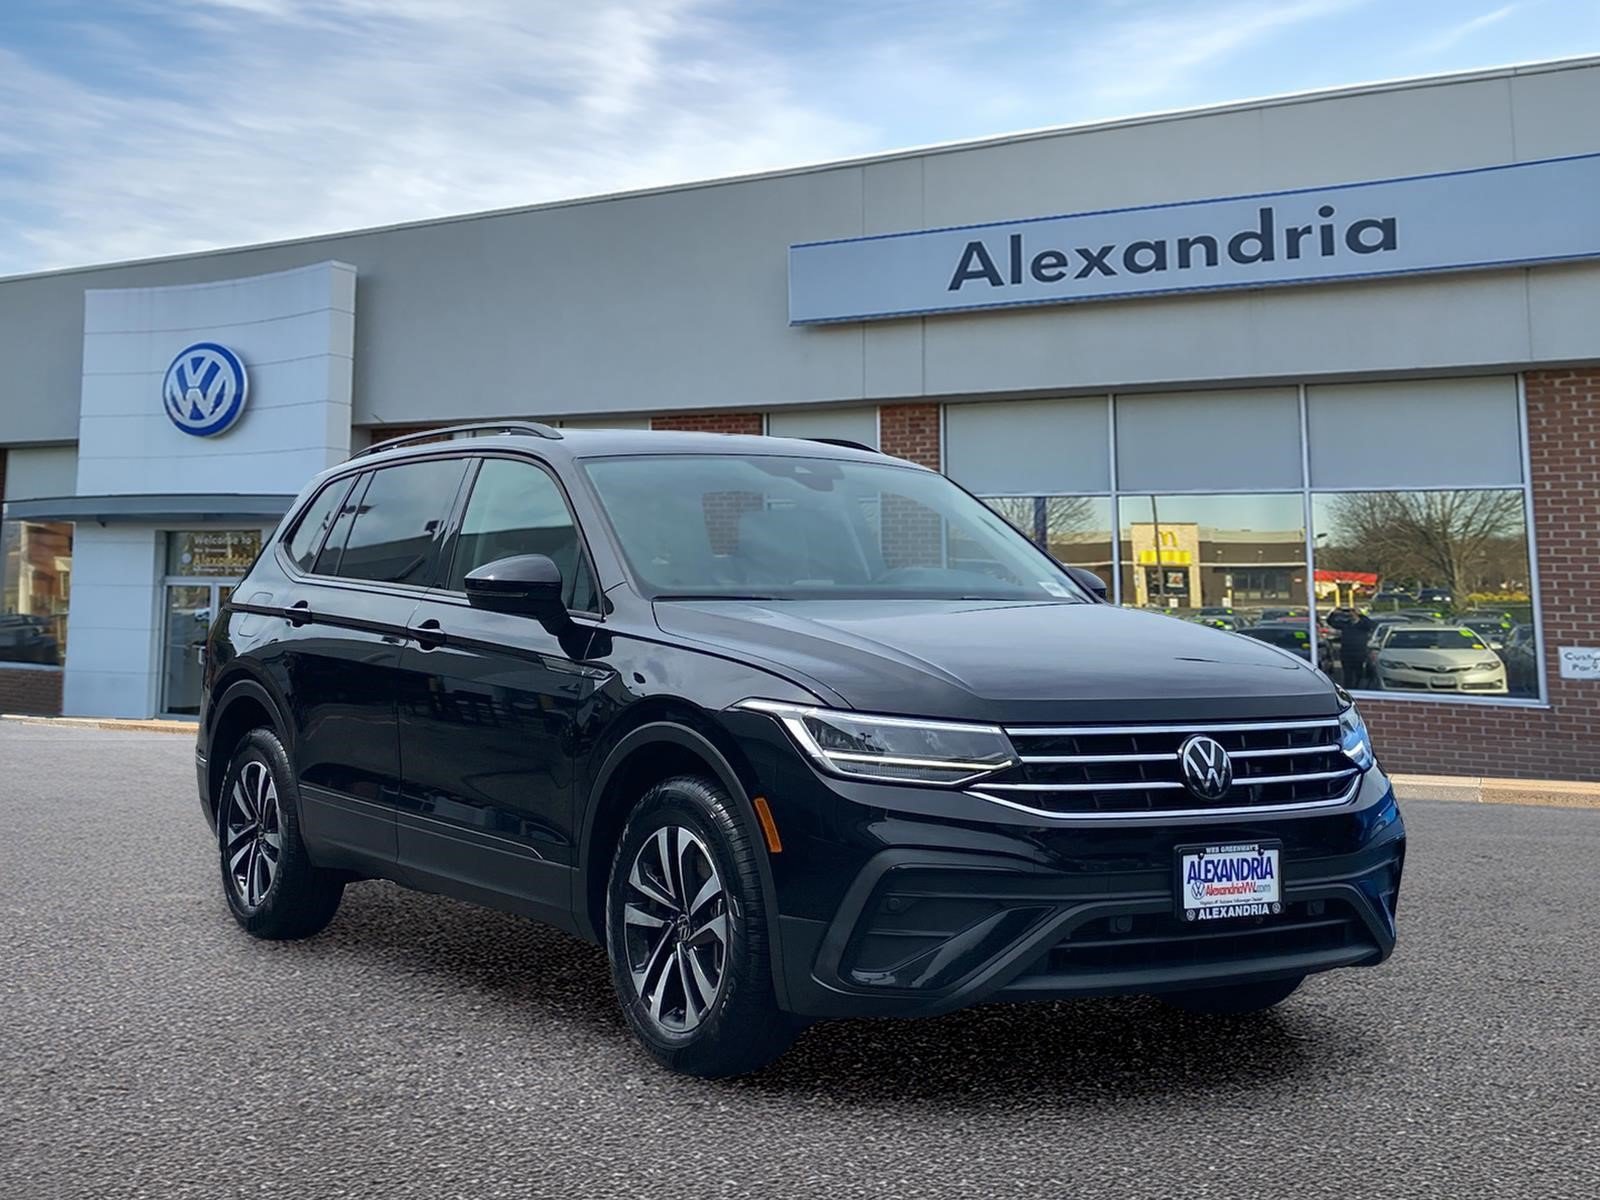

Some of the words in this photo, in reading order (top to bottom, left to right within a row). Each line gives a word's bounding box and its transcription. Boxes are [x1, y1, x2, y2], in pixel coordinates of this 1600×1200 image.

[948, 205, 1397, 291] Alexandria
[1187, 856, 1273, 884] ALEXANDRIA
[1198, 903, 1270, 920] ALEXANDRIA
